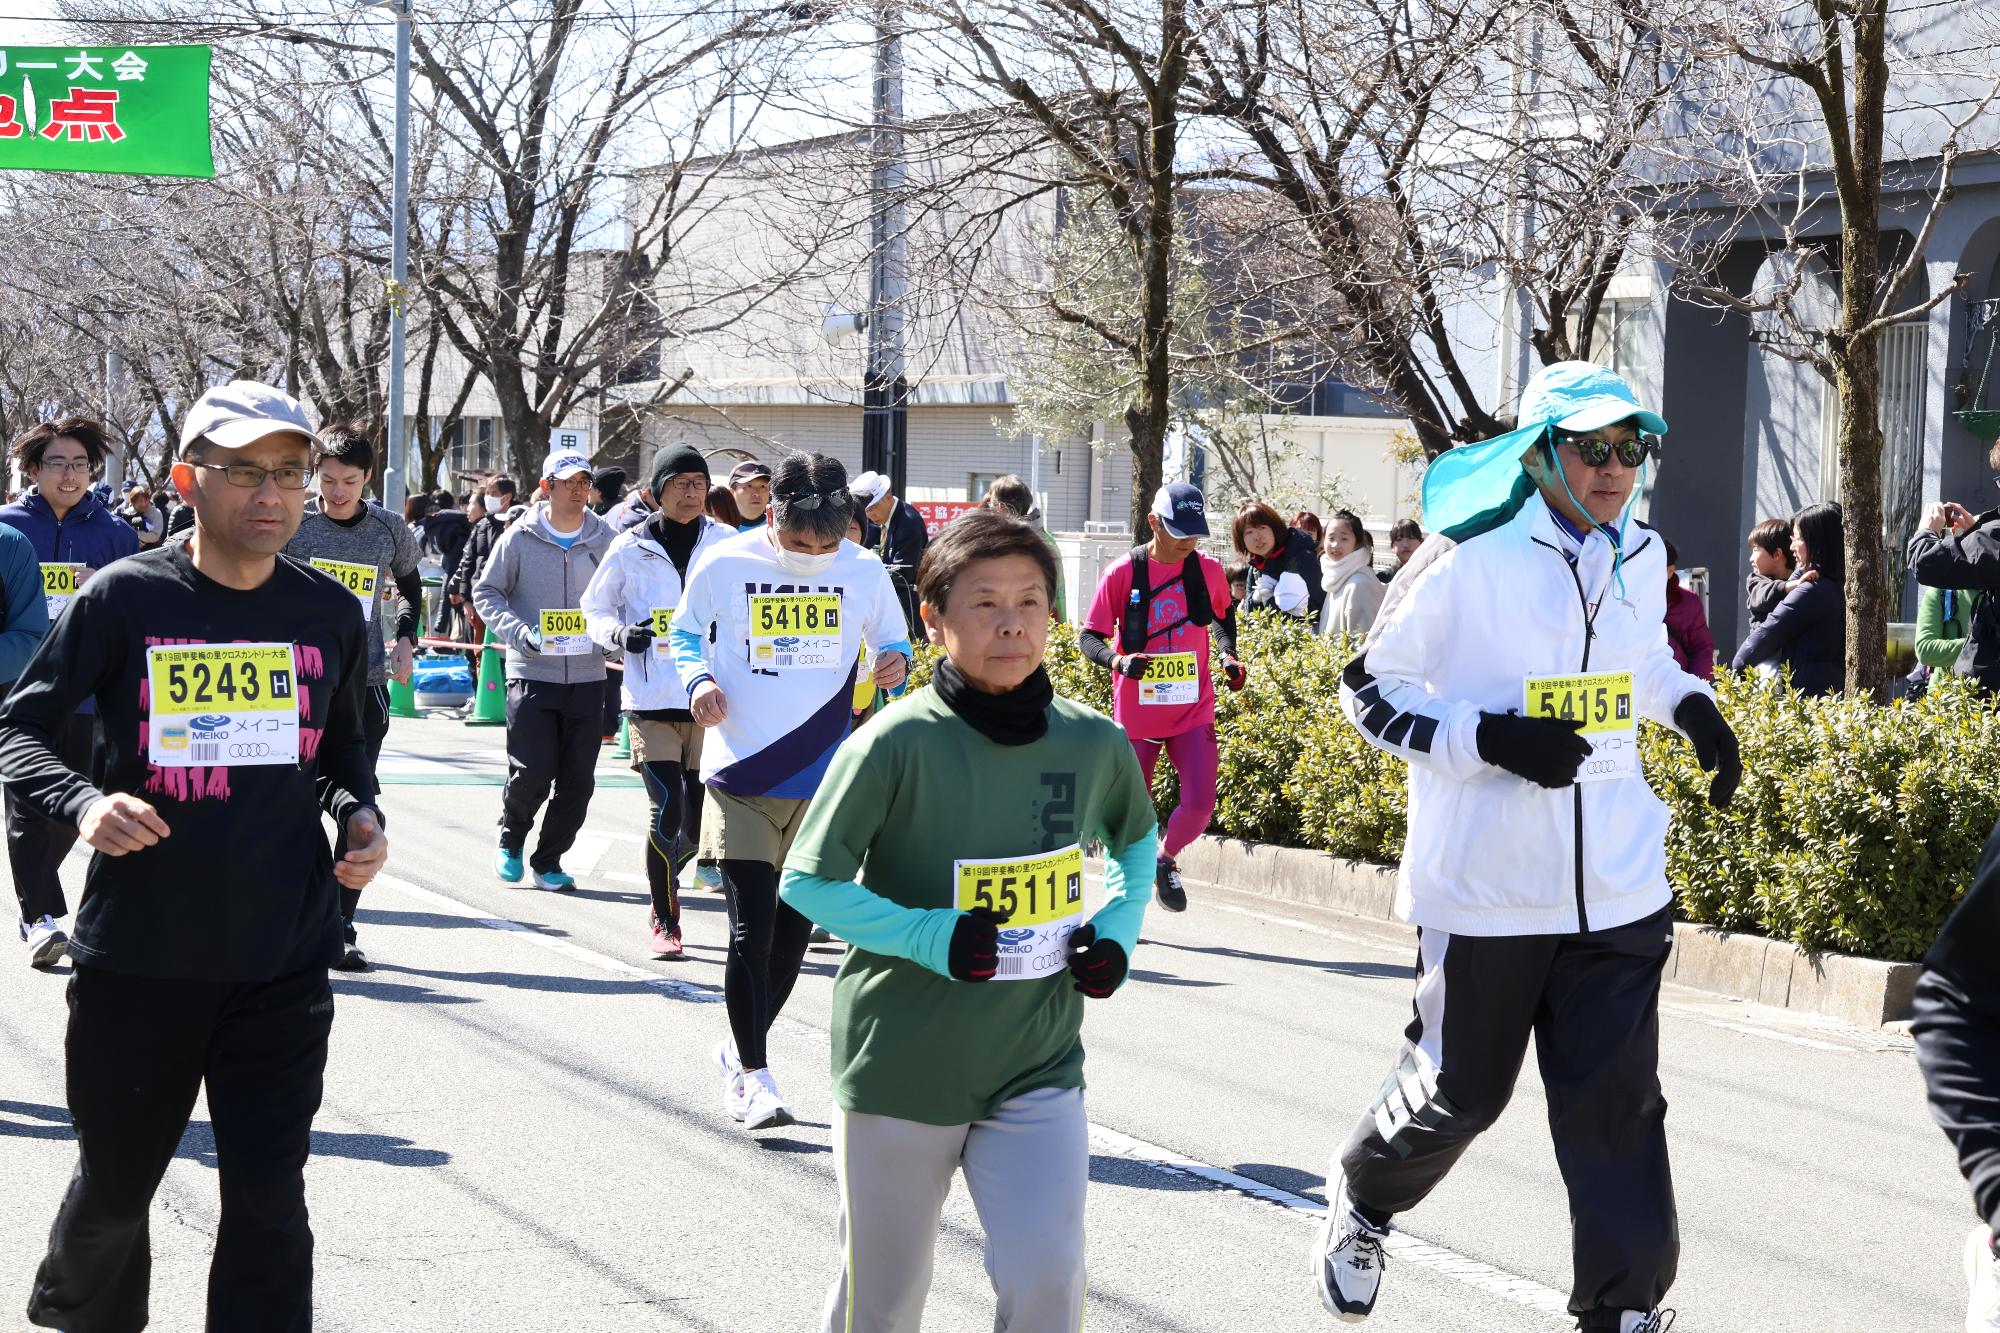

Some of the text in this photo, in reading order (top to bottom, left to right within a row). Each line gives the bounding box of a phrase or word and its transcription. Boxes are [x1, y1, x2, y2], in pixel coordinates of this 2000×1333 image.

[547, 615, 581, 631] 5004
[761, 604, 837, 630] 5418 H
[802, 640, 840, 649] メイコー
[155, 650, 287, 662] 第19回甲斐梅の里クロスカントリー大会
[1146, 660, 1185, 679] 5208
[169, 662, 260, 703] 5243
[271, 673, 290, 696] H
[1541, 687, 1629, 724] 5415 H
[235, 719, 295, 733] メイコー
[192, 731, 229, 740] MEIKO
[1591, 738, 1633, 751] メイコー
[962, 850, 1080, 877] 第19回甲斐梅の里クロスカントリー大会
[975, 870, 1080, 916] 5511 H
